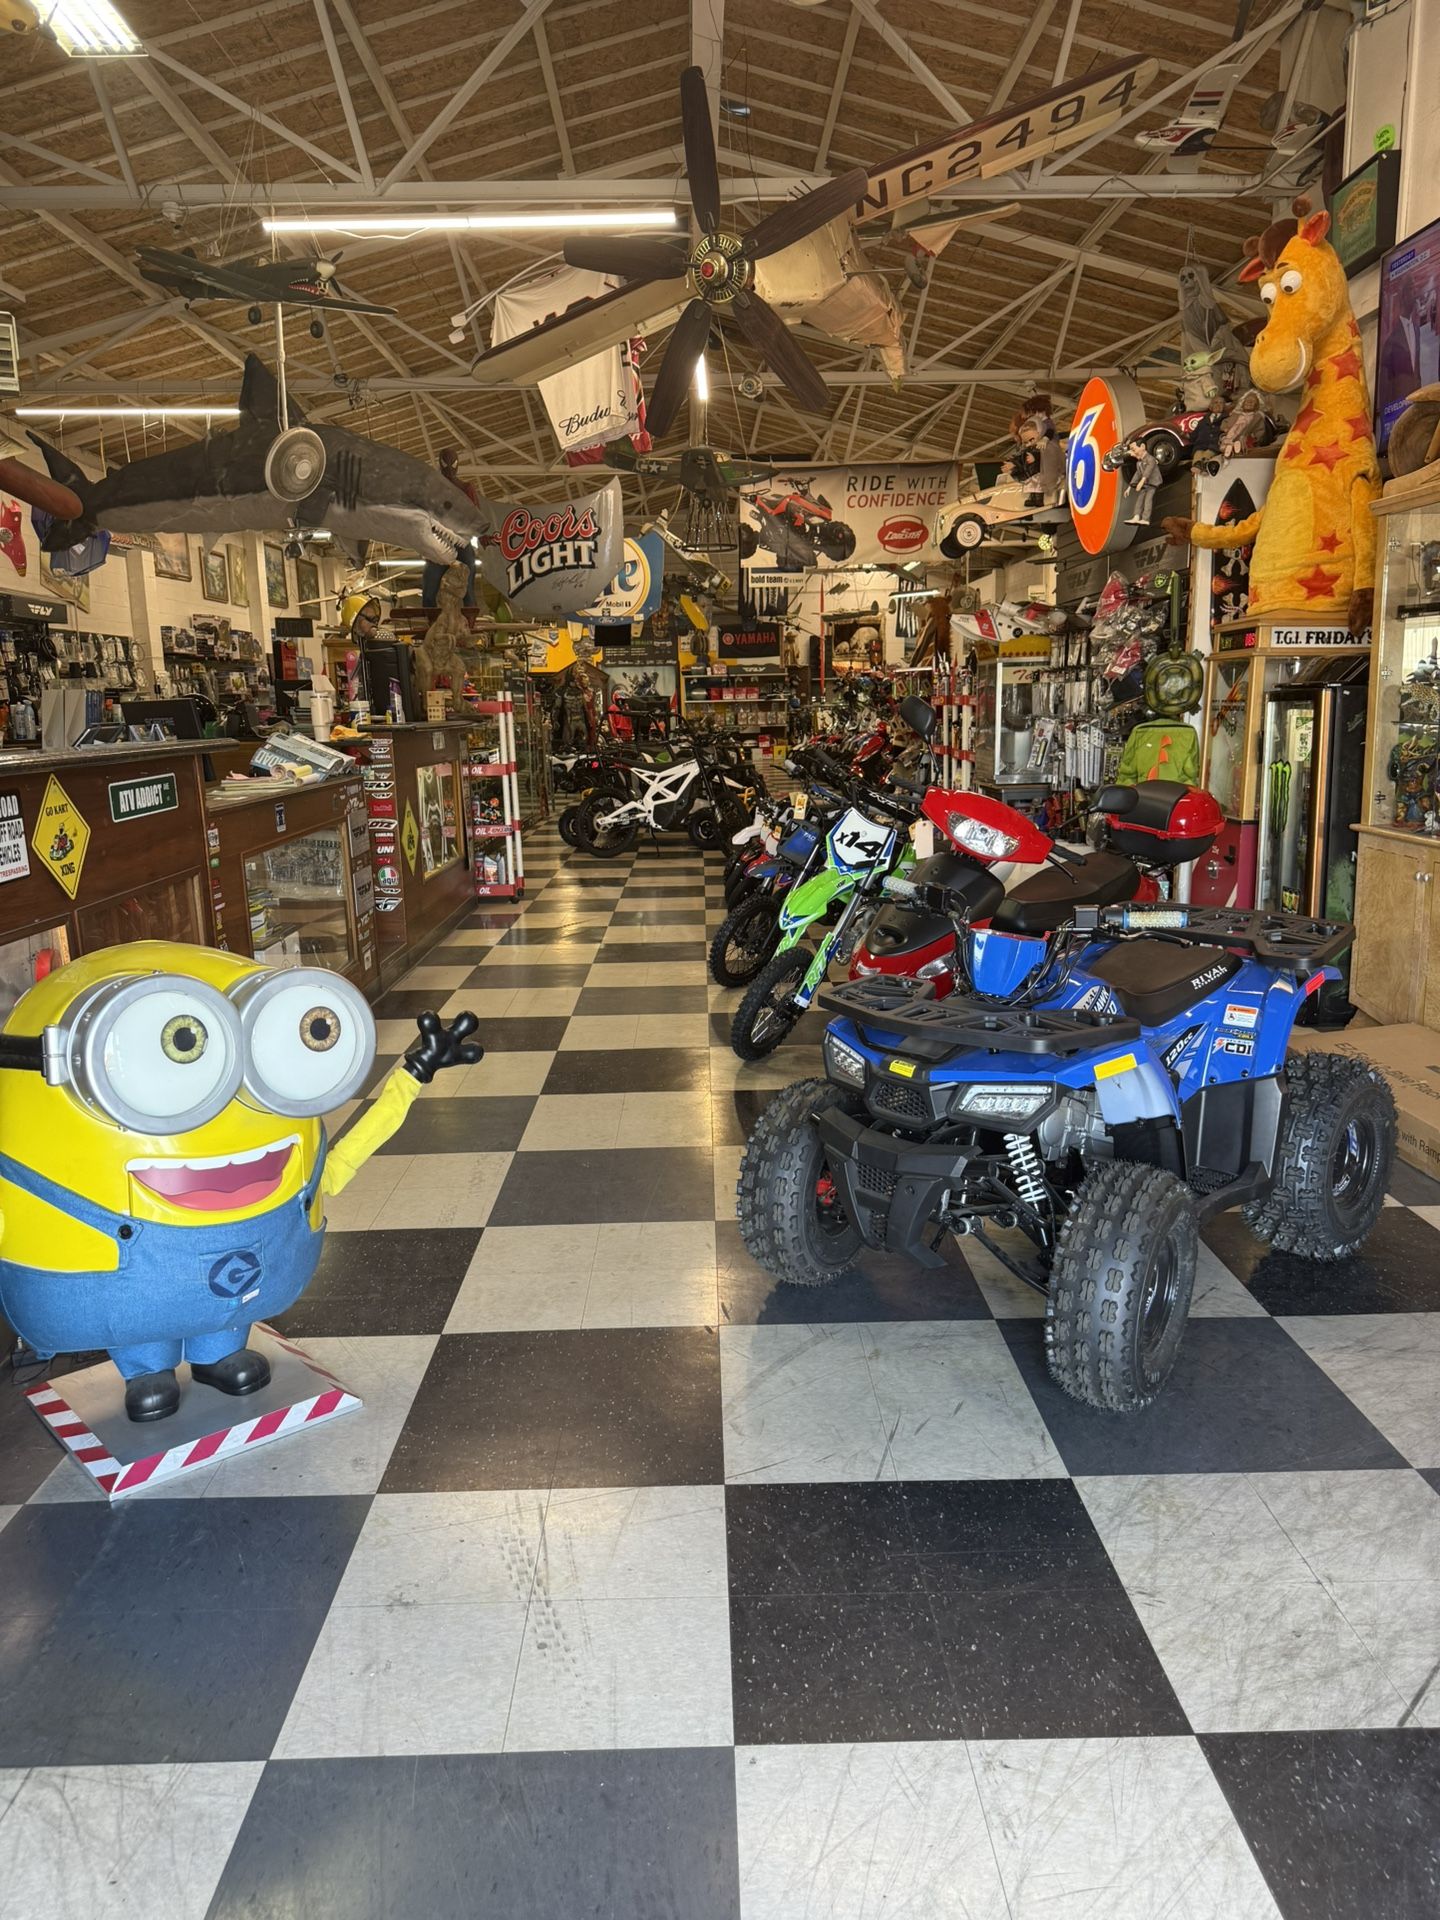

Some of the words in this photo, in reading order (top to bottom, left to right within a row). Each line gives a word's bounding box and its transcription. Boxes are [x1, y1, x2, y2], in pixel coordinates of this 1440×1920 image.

[856, 70, 1137, 218] NC2494
[1068, 402, 1107, 515] 76
[847, 475, 896, 492] RIDE
[906, 476, 948, 491] WITH
[847, 491, 947, 509] CONFIDENCE
[492, 504, 602, 561] Coors
[506, 539, 599, 599] LIGHT
[750, 575, 765, 584] bold
[766, 575, 783, 584] team
[28, 603, 53, 616] FLY
[735, 632, 776, 645] YAMAHA
[1274, 630, 1302, 645] T.G.I.
[471, 766, 483, 775] OIL
[0, 794, 19, 818] OAD
[119, 789, 135, 813] ATV
[135, 783, 163, 809] ADDICT
[45, 805, 54, 817] GO
[54, 803, 69, 815] KART
[475, 827, 487, 835] OIL
[376, 845, 395, 854] UNI
[835, 831, 884, 858] x14
[60, 862, 75, 877] XING
[479, 887, 491, 895] OIL
[1191, 965, 1228, 986] RIVAL
[1165, 1031, 1194, 1067] 120cc
[1225, 1042, 1252, 1055] CDI
[1401, 1131, 1418, 1148] with
